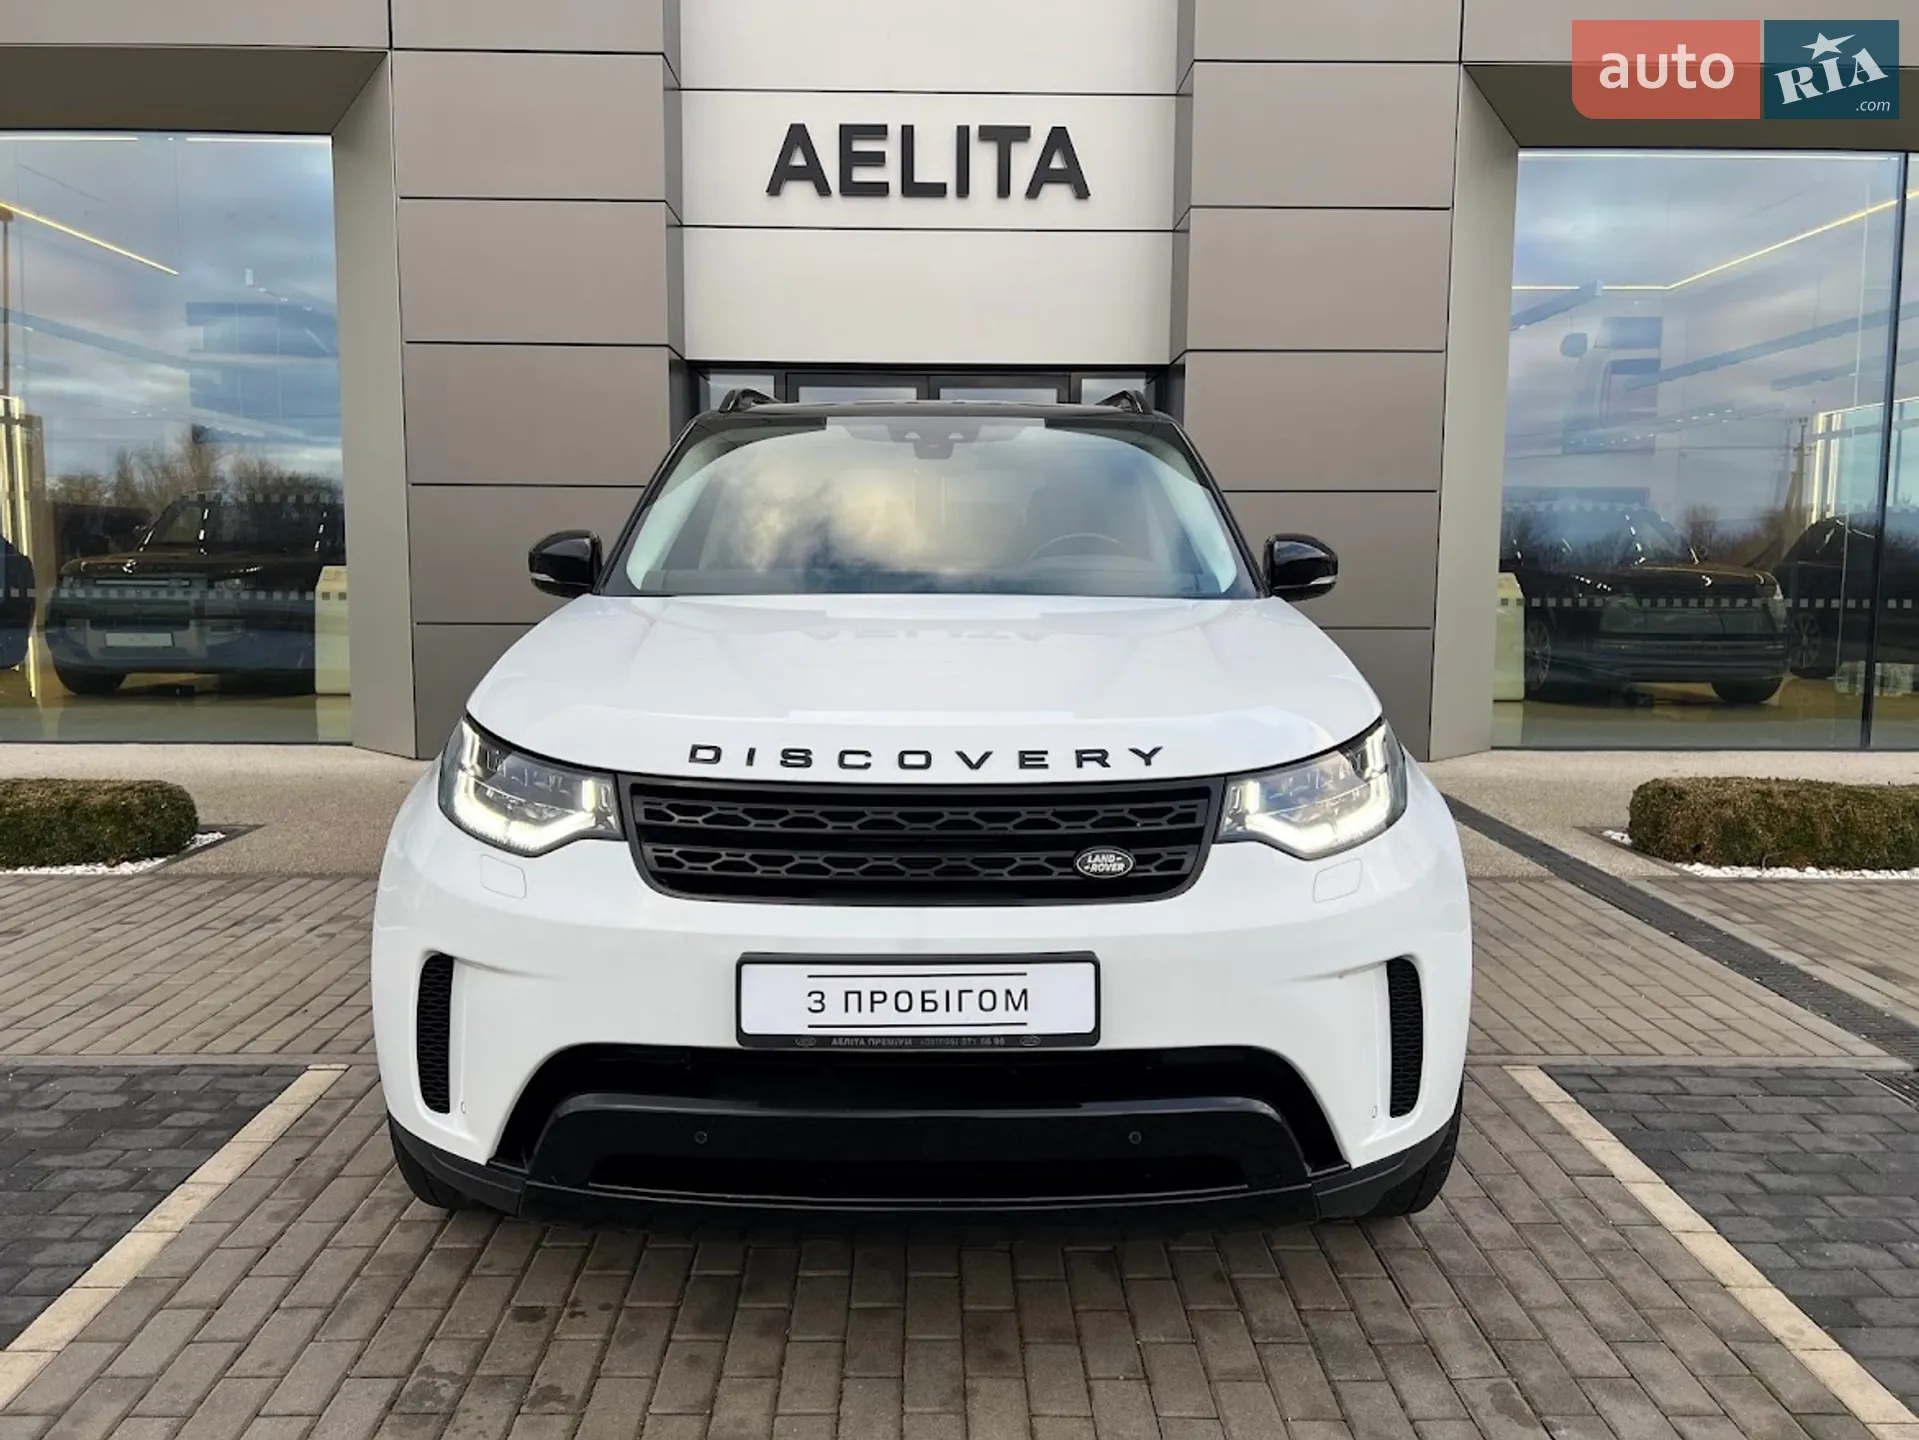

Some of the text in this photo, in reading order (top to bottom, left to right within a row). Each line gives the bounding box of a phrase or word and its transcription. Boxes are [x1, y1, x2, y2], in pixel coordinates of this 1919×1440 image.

[765, 123, 1091, 201] AELITA
[688, 743, 1163, 770] DISCOVERY
[1087, 854, 1116, 863] LAND
[1089, 862, 1125, 872] ROVER
[807, 988, 1029, 1014] З ПРОБІГОМ
